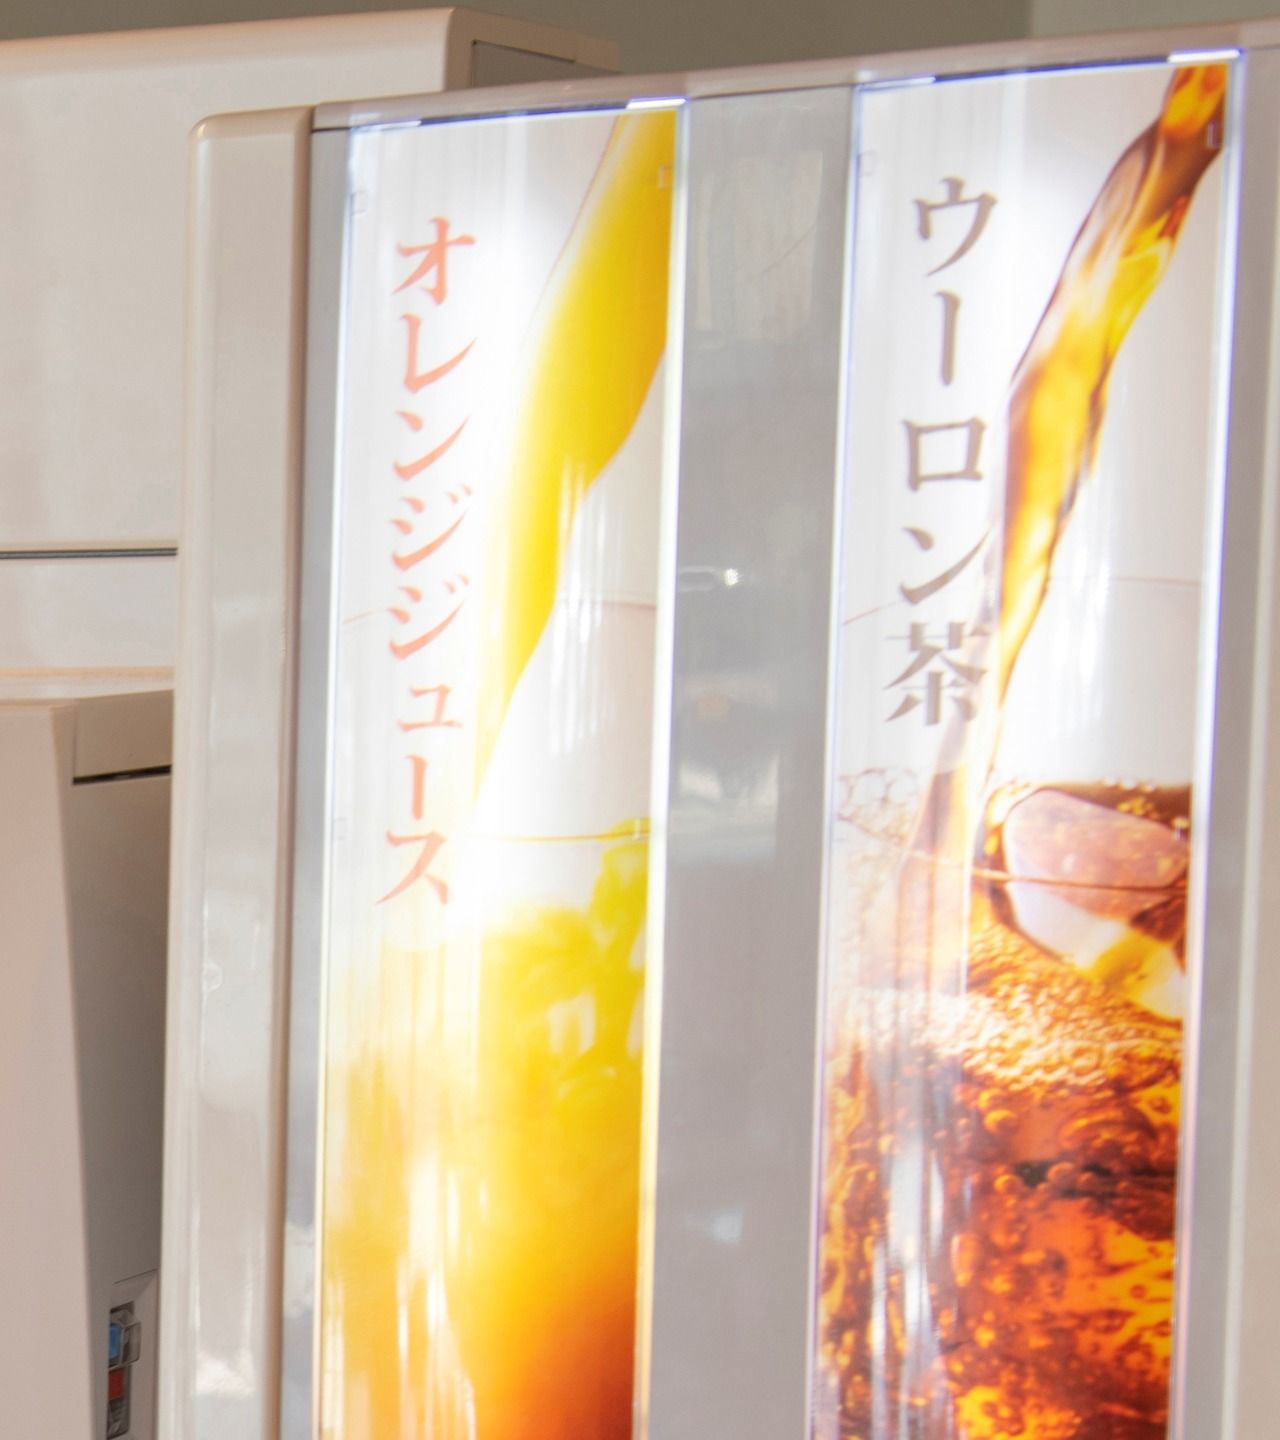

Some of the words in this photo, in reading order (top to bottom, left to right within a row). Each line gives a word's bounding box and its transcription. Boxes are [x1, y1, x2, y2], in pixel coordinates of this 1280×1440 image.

[376, 215, 477, 905] オレンジジュース
[882, 176, 998, 727] ウーロン茶
